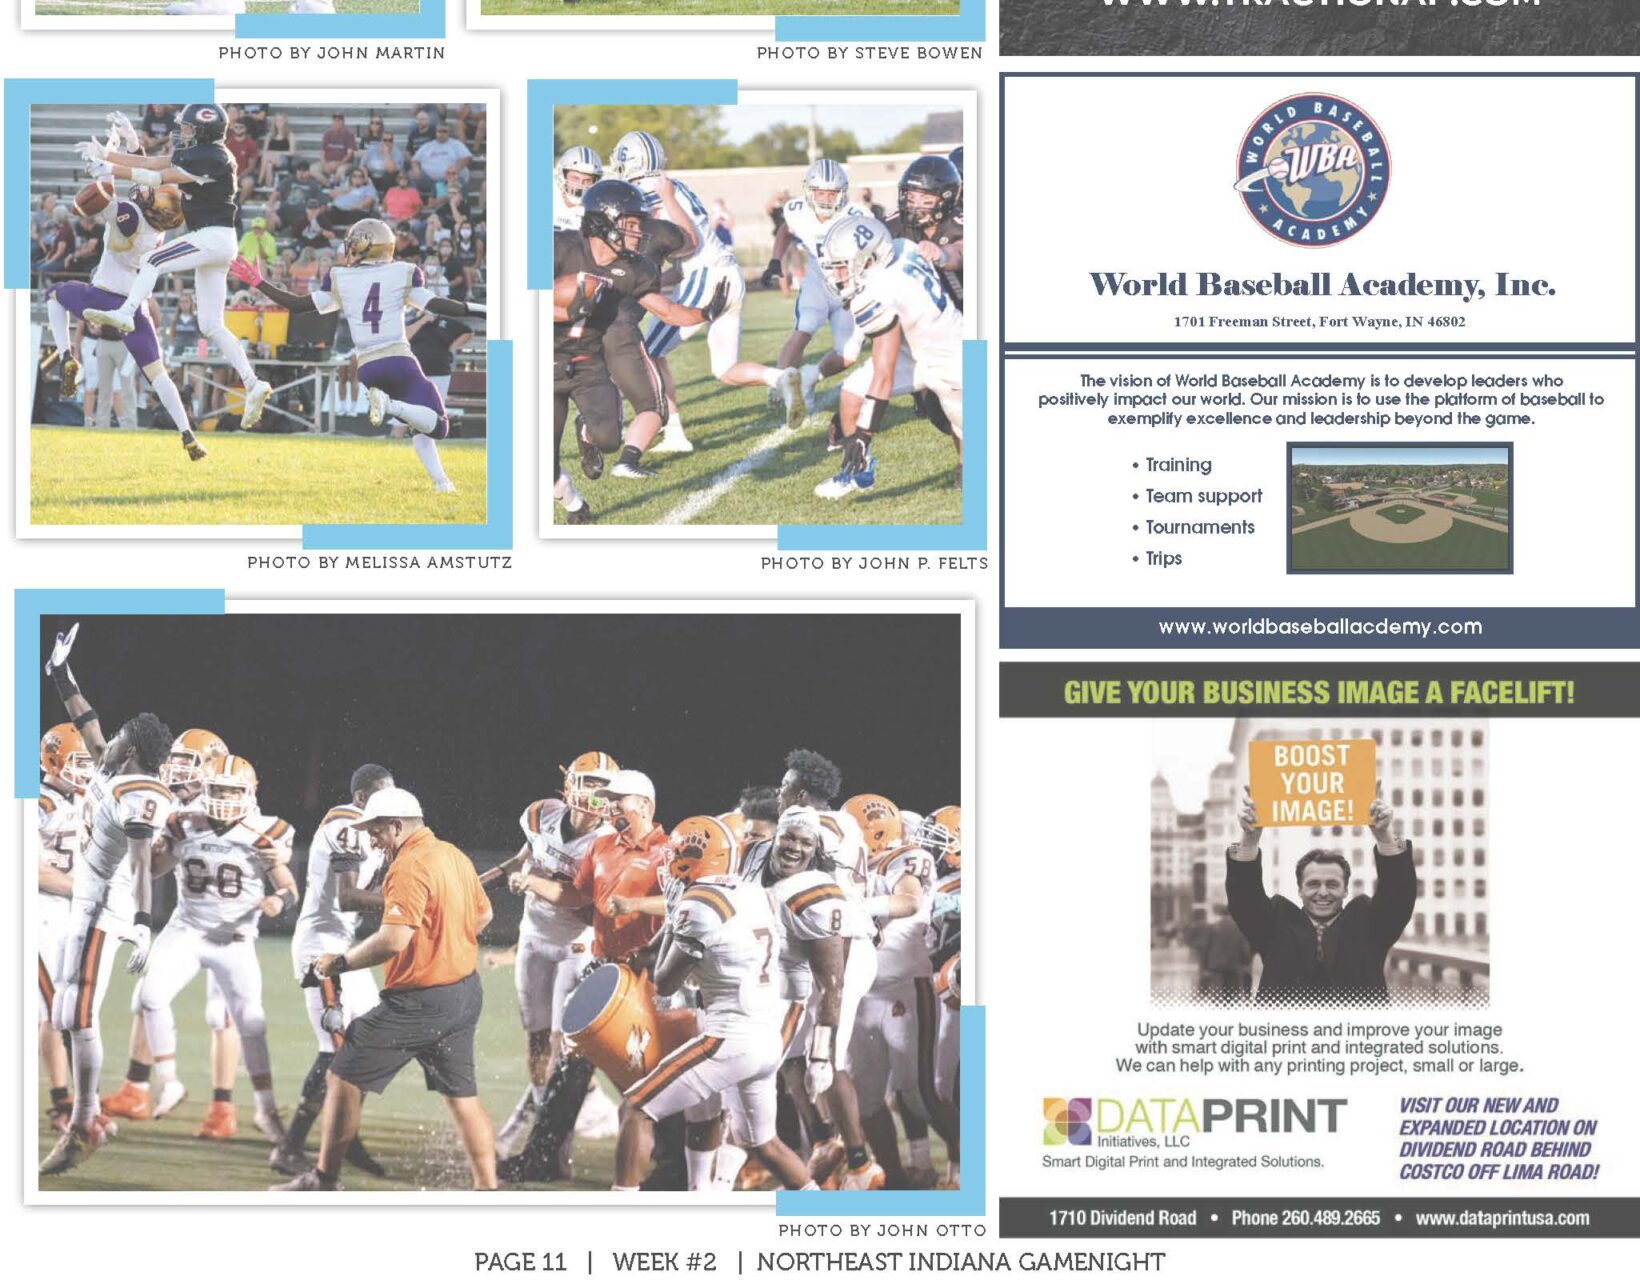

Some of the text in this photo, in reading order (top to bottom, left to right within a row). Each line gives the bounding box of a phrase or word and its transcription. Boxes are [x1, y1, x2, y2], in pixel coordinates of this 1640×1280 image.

[218, 46, 445, 60] PHOTO BY JOHN MARTIN
[757, 46, 983, 60] PHOTO BY STEVE BOWEN
[1246, 101, 1383, 182] WORLD BASEBALL
[1284, 143, 1358, 184] WBA
[1272, 206, 1368, 241] ACADEMY
[1088, 271, 1556, 304] World Baseball Academy, Inc.
[362, 282, 384, 335] 4
[1174, 316, 1466, 331] 1701 Freeman Street, Fort Wayne, IN 46802
[1080, 373, 1564, 391] The vision of World Baseball Academy is to develop leaders who
[1145, 456, 1213, 476] Training
[1145, 488, 1264, 507] Team support
[1145, 519, 1255, 535] Tournaments
[247, 556, 512, 569] PHOTO BY MELISSA AMSTUTZ
[760, 556, 988, 570] PHOTO BY JOHN P. FELTS
[1145, 550, 1183, 569] Trips
[1158, 617, 1483, 639] www.worldbaseballacdemy.com
[1064, 680, 1574, 704] GIVE YOUR BUSINESS IMAGE A FACELIFT!
[1274, 744, 1350, 767] BOOST
[1281, 771, 1344, 794] YOUR
[1273, 799, 1353, 821] IMAGE!
[904, 856, 933, 879] 58
[830, 908, 842, 931] 8
[752, 926, 774, 984] 7
[1115, 1057, 1524, 1076] We can help with any printing project, small or large.
[1399, 1096, 1560, 1114] VISIT OUR NEW AND
[1097, 1098, 1349, 1133] DATAPRINT
[1399, 1119, 1598, 1136] EXPANDED LOCATION ON
[1050, 1209, 1197, 1226] 1710 Dividend Road
[1232, 1209, 1381, 1226] Phone 260.489.2665
[1415, 1210, 1590, 1229] www.dataprintusa.com
[778, 1224, 987, 1237] PHOTO BY JOHN OTTO
[474, 1252, 1167, 1272] PAGE 11 WEEK #2 NORTHEAST INDIANA GAMENIGHT
